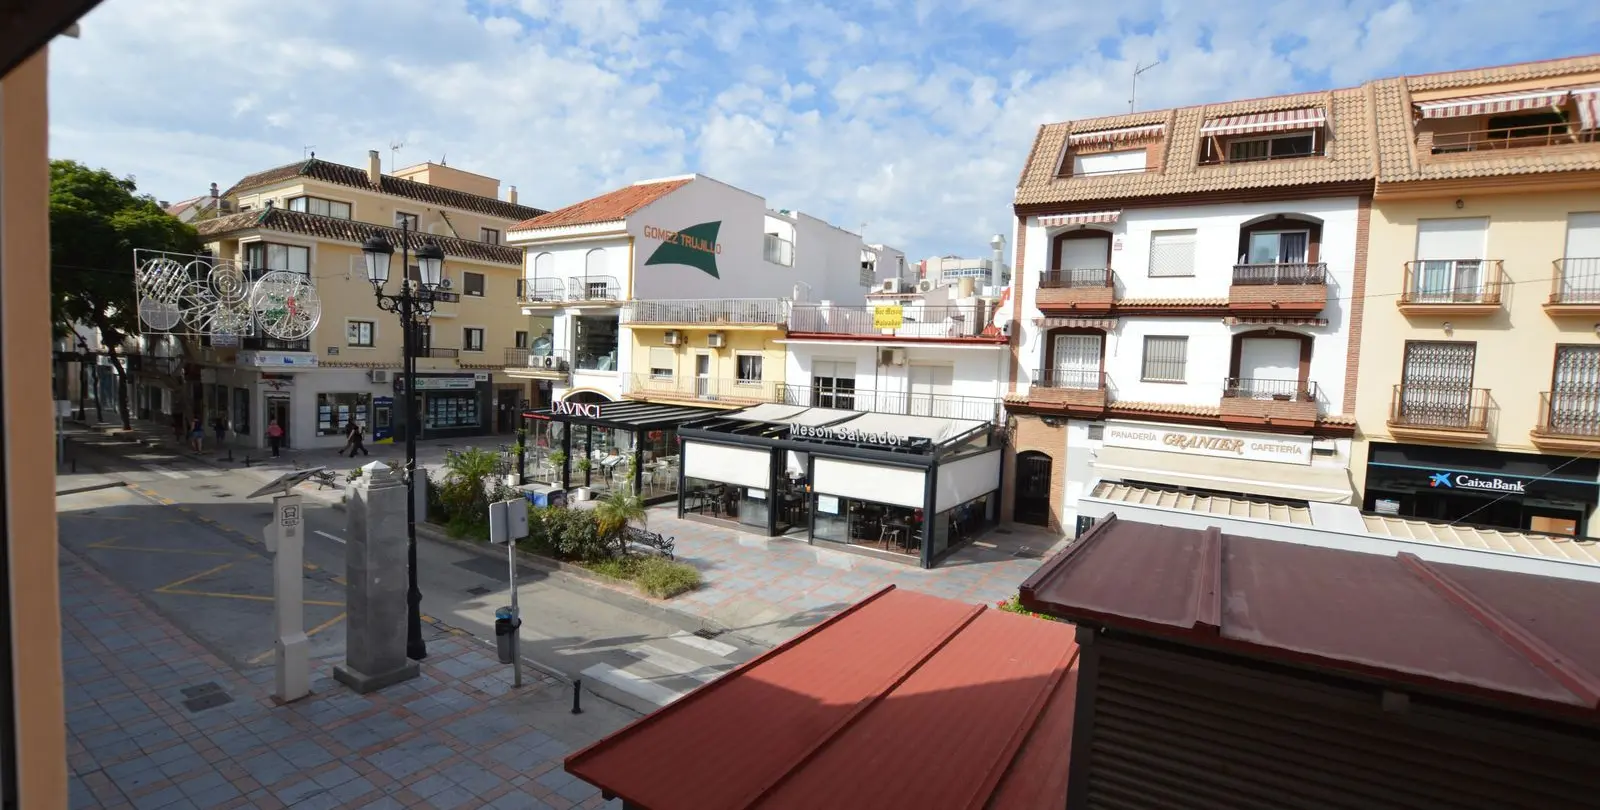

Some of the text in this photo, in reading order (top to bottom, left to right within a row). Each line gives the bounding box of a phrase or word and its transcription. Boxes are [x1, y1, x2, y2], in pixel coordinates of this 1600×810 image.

[644, 225, 721, 254] GOMEZ TRUJILLO
[837, 426, 904, 446] Salvador
[1110, 429, 1302, 455] PANADERÍA GRANIER CAFETERÍA
[1455, 475, 1525, 492] CaixaBank
